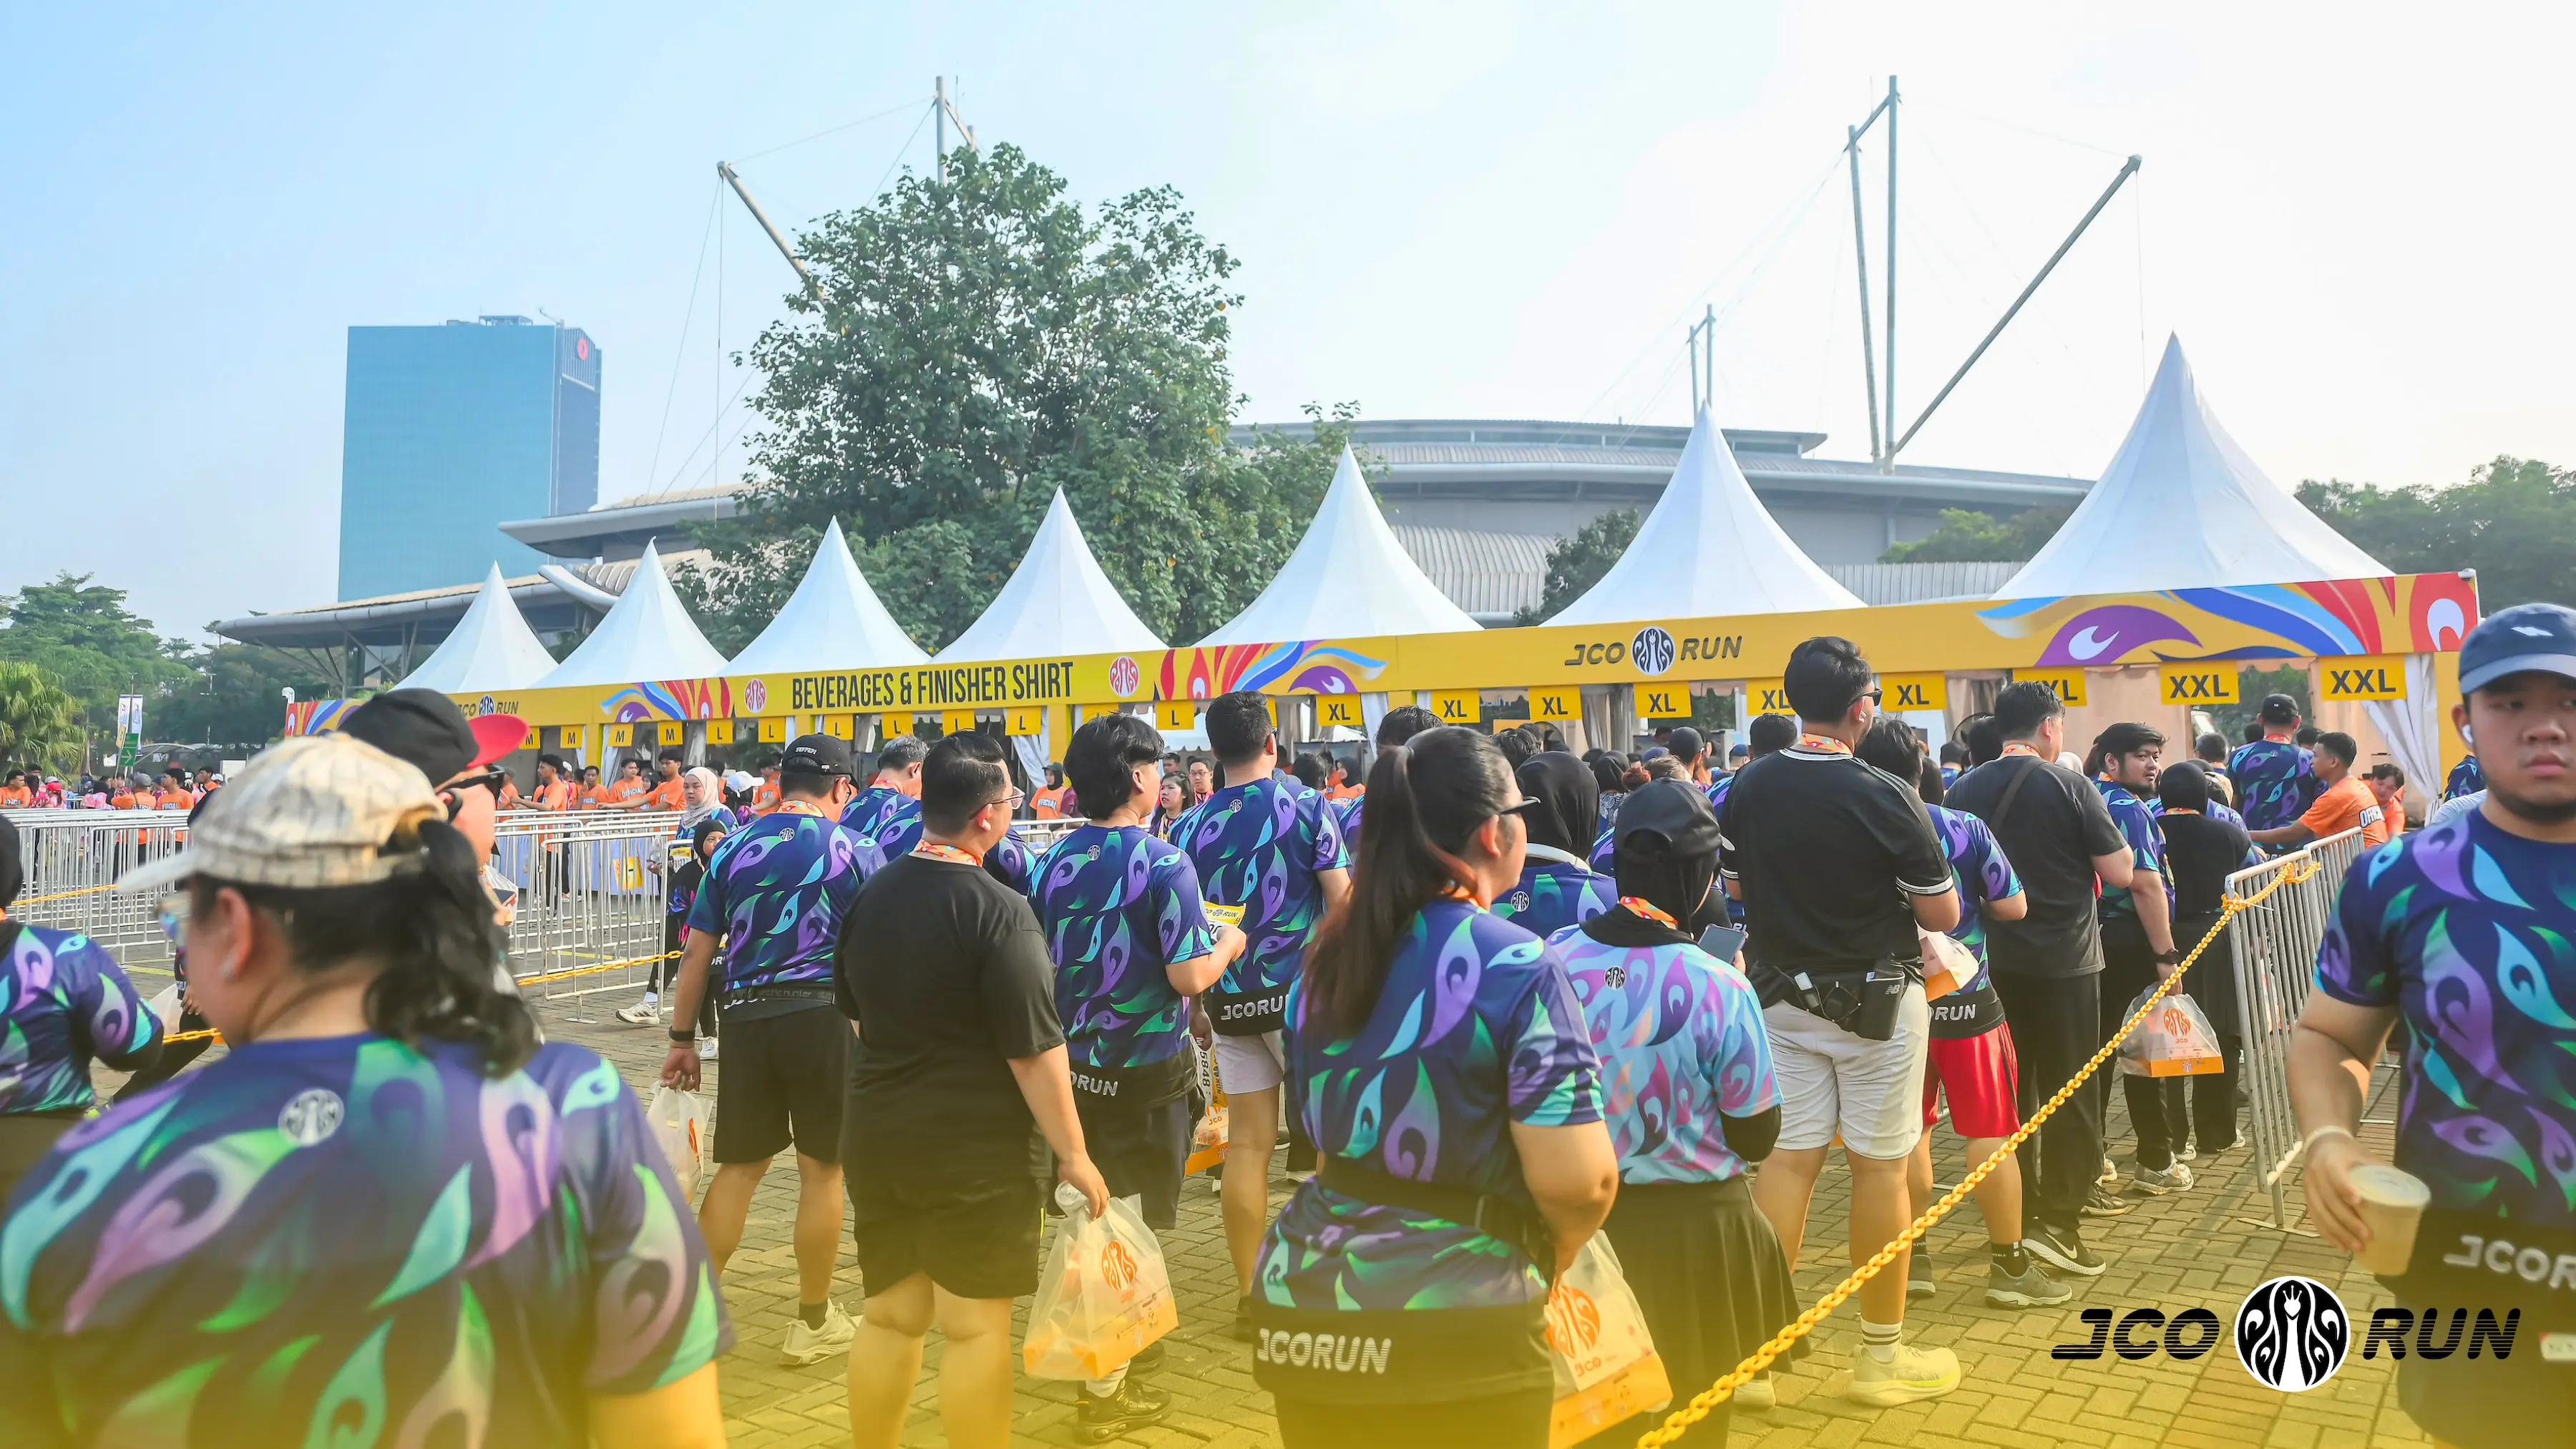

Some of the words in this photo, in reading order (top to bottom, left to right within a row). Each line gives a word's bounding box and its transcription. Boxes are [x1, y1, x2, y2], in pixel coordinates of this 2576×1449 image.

[1564, 641, 1626, 666] JCO
[1680, 635, 1743, 660] RUN
[792, 671, 894, 709] BEVERAGES
[900, 672, 912, 705] &
[917, 665, 1006, 704] FINISHER
[1013, 661, 1073, 699] SHIRT
[2170, 674, 2230, 698] XXL
[2331, 668, 2396, 694] XXL
[1649, 693, 1676, 713] XL
[1761, 689, 1790, 710] XL
[1897, 684, 1930, 706] XL
[496, 701, 518, 714] RUN
[1328, 703, 1351, 721] XL
[1443, 699, 1468, 718] XL
[1542, 696, 1568, 715] XL
[894, 720, 902, 734] L
[1019, 716, 1026, 730] L
[1171, 710, 1179, 726] L
[615, 730, 625, 742] M
[666, 728, 675, 741] M
[717, 727, 723, 739] L
[769, 725, 774, 738] L
[835, 722, 841, 736] L
[525, 733, 533, 745] M
[568, 733, 576, 744] M
[1221, 994, 1289, 1020] JCORU
[1930, 1004, 1976, 1020] RUN
[1200, 1051, 1211, 1087] 5848
[1208, 1116, 1222, 1126] JCO
[1257, 1328, 1392, 1374] JCORUN
[1574, 1357, 1602, 1378] JCO
